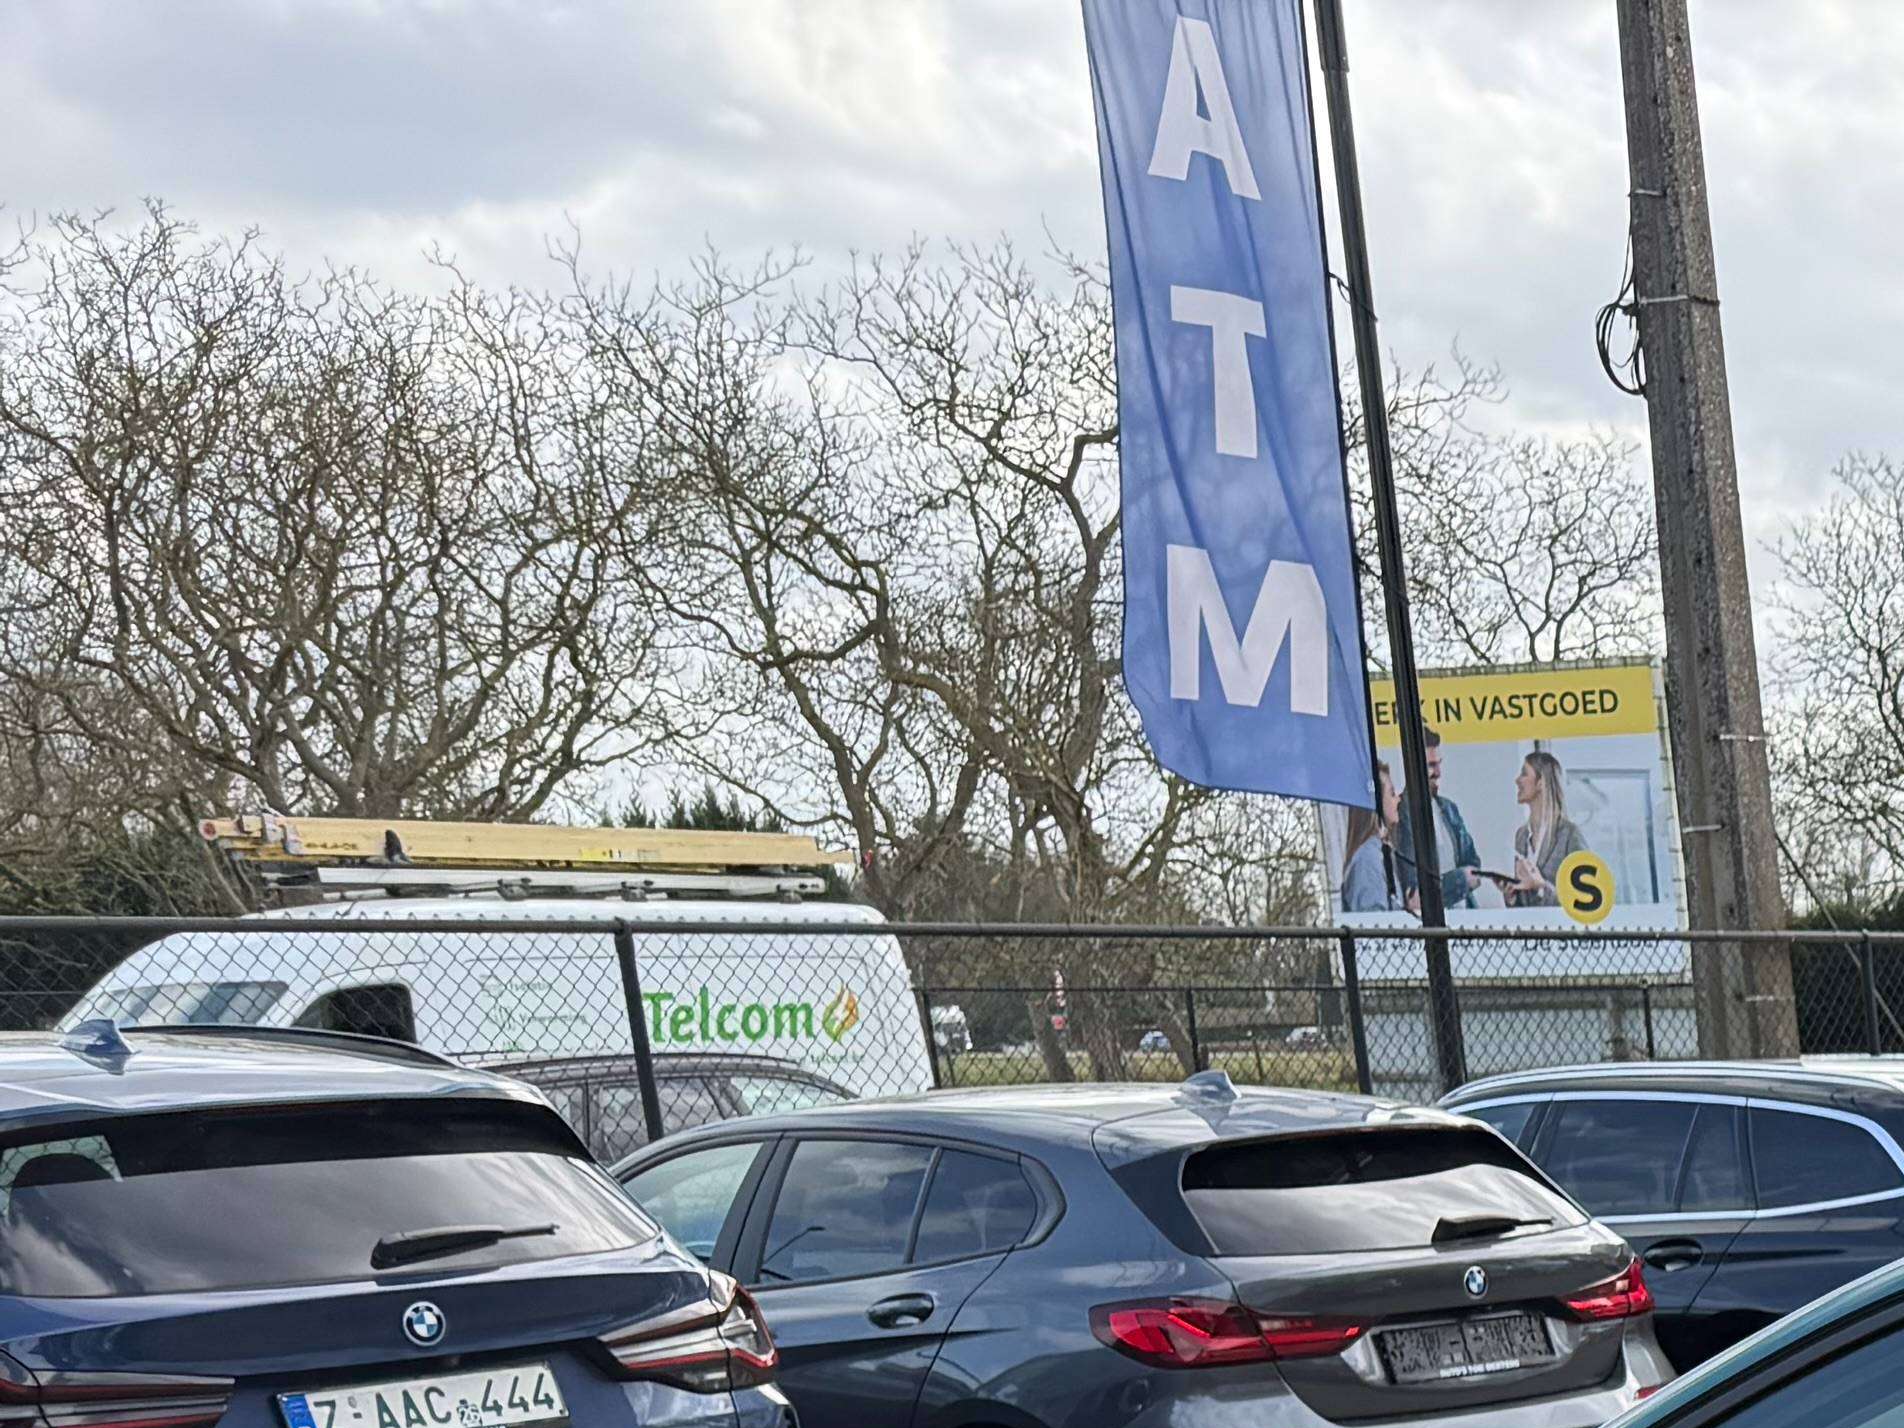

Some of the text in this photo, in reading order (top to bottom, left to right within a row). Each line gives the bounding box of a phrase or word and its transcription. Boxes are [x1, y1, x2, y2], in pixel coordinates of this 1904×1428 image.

[1148, 16, 1330, 717] ATM
[1435, 697, 1462, 723] IN
[1469, 688, 1619, 721] VASTGOED
[1570, 864, 1603, 912] S
[643, 985, 816, 1043] Telcom
